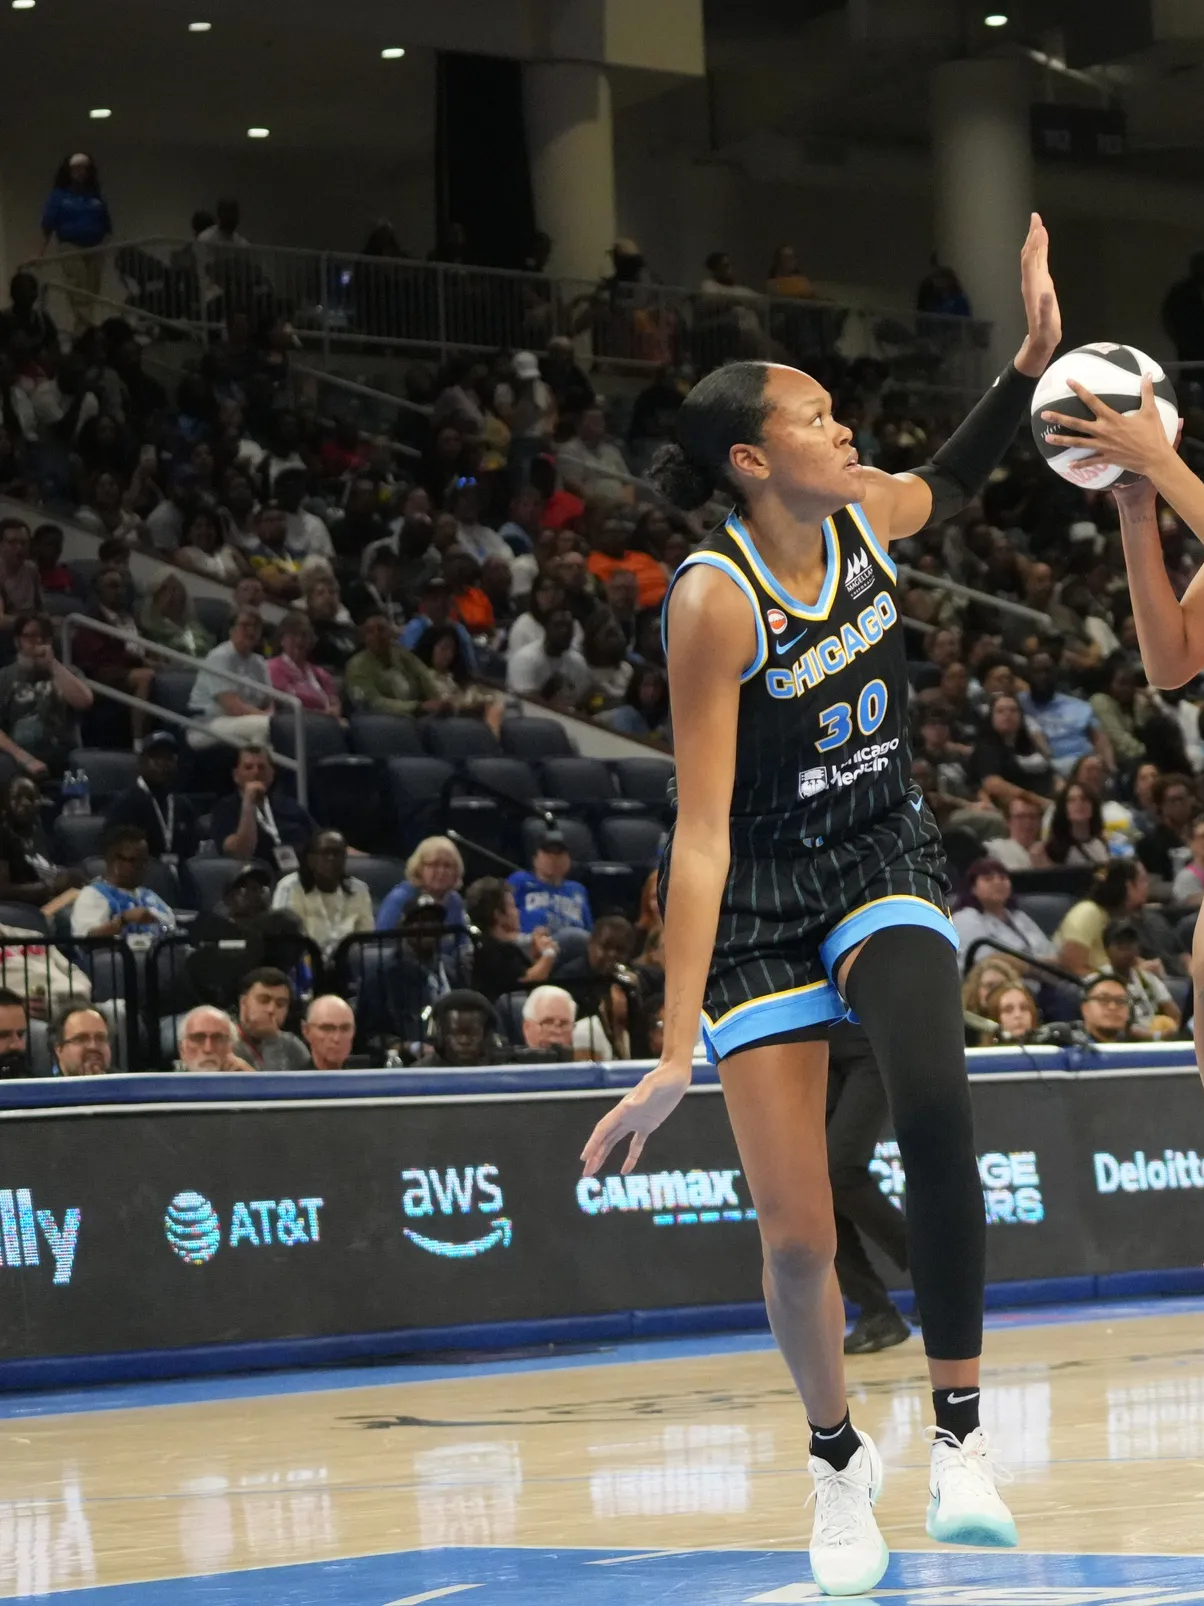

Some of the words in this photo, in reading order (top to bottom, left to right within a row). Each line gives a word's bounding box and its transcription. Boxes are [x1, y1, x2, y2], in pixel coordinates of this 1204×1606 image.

[765, 590, 898, 698] CHICAGO
[814, 678, 889, 753] 30
[229, 1197, 325, 1247] AT&T
[401, 1164, 504, 1217] aws
[0, 1188, 81, 1286] lly
